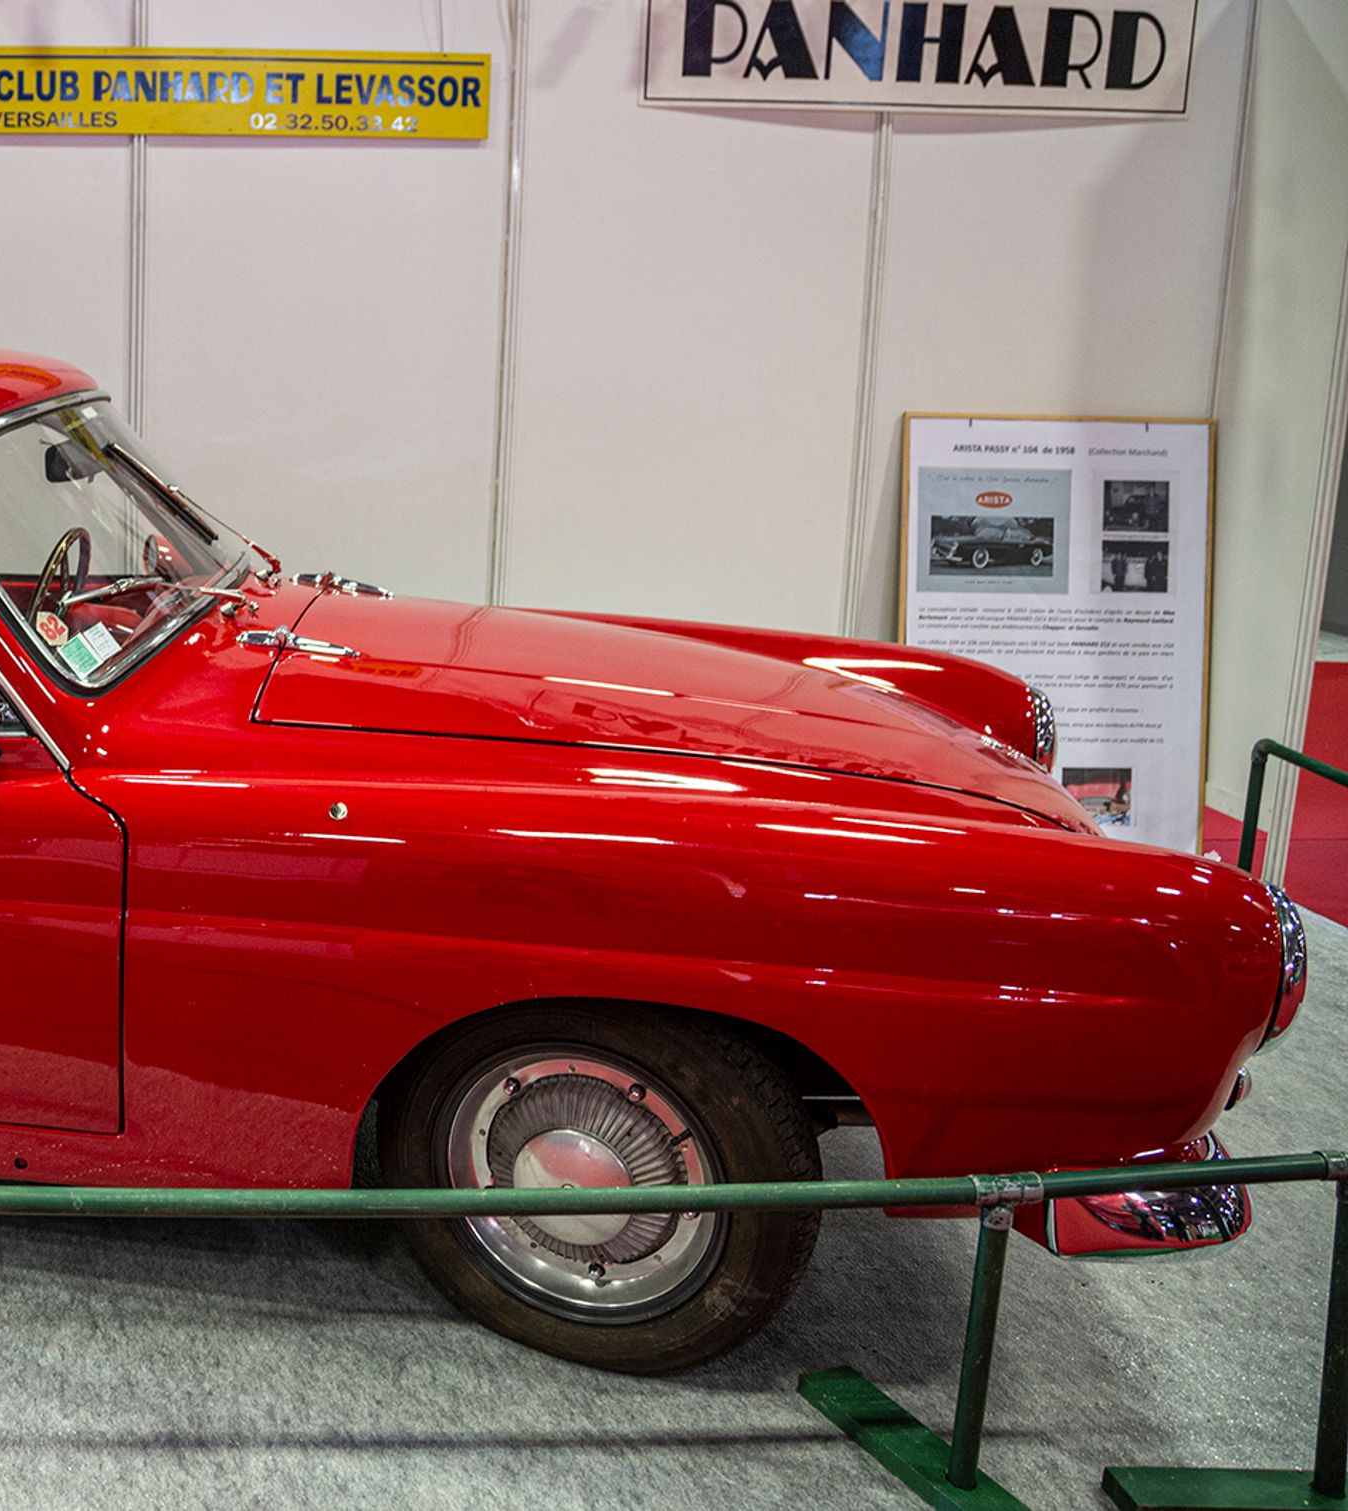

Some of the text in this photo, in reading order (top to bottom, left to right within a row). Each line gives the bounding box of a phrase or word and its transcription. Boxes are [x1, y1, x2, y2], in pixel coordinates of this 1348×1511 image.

[680, 0, 1167, 90] PANHARD
[93, 70, 255, 104] PANHARD
[265, 72, 306, 104] ET
[316, 73, 482, 107] LEVASSOR
[249, 112, 419, 132] 02.32.50.33.42
[953, 443, 982, 452] ARISTA
[984, 444, 1009, 453] PASSY
[1023, 446, 1038, 454] 104
[1042, 446, 1052, 454] de
[1055, 446, 1075, 455] 1958
[977, 495, 1011, 504] ARISTA
[40, 615, 65, 640] 82
